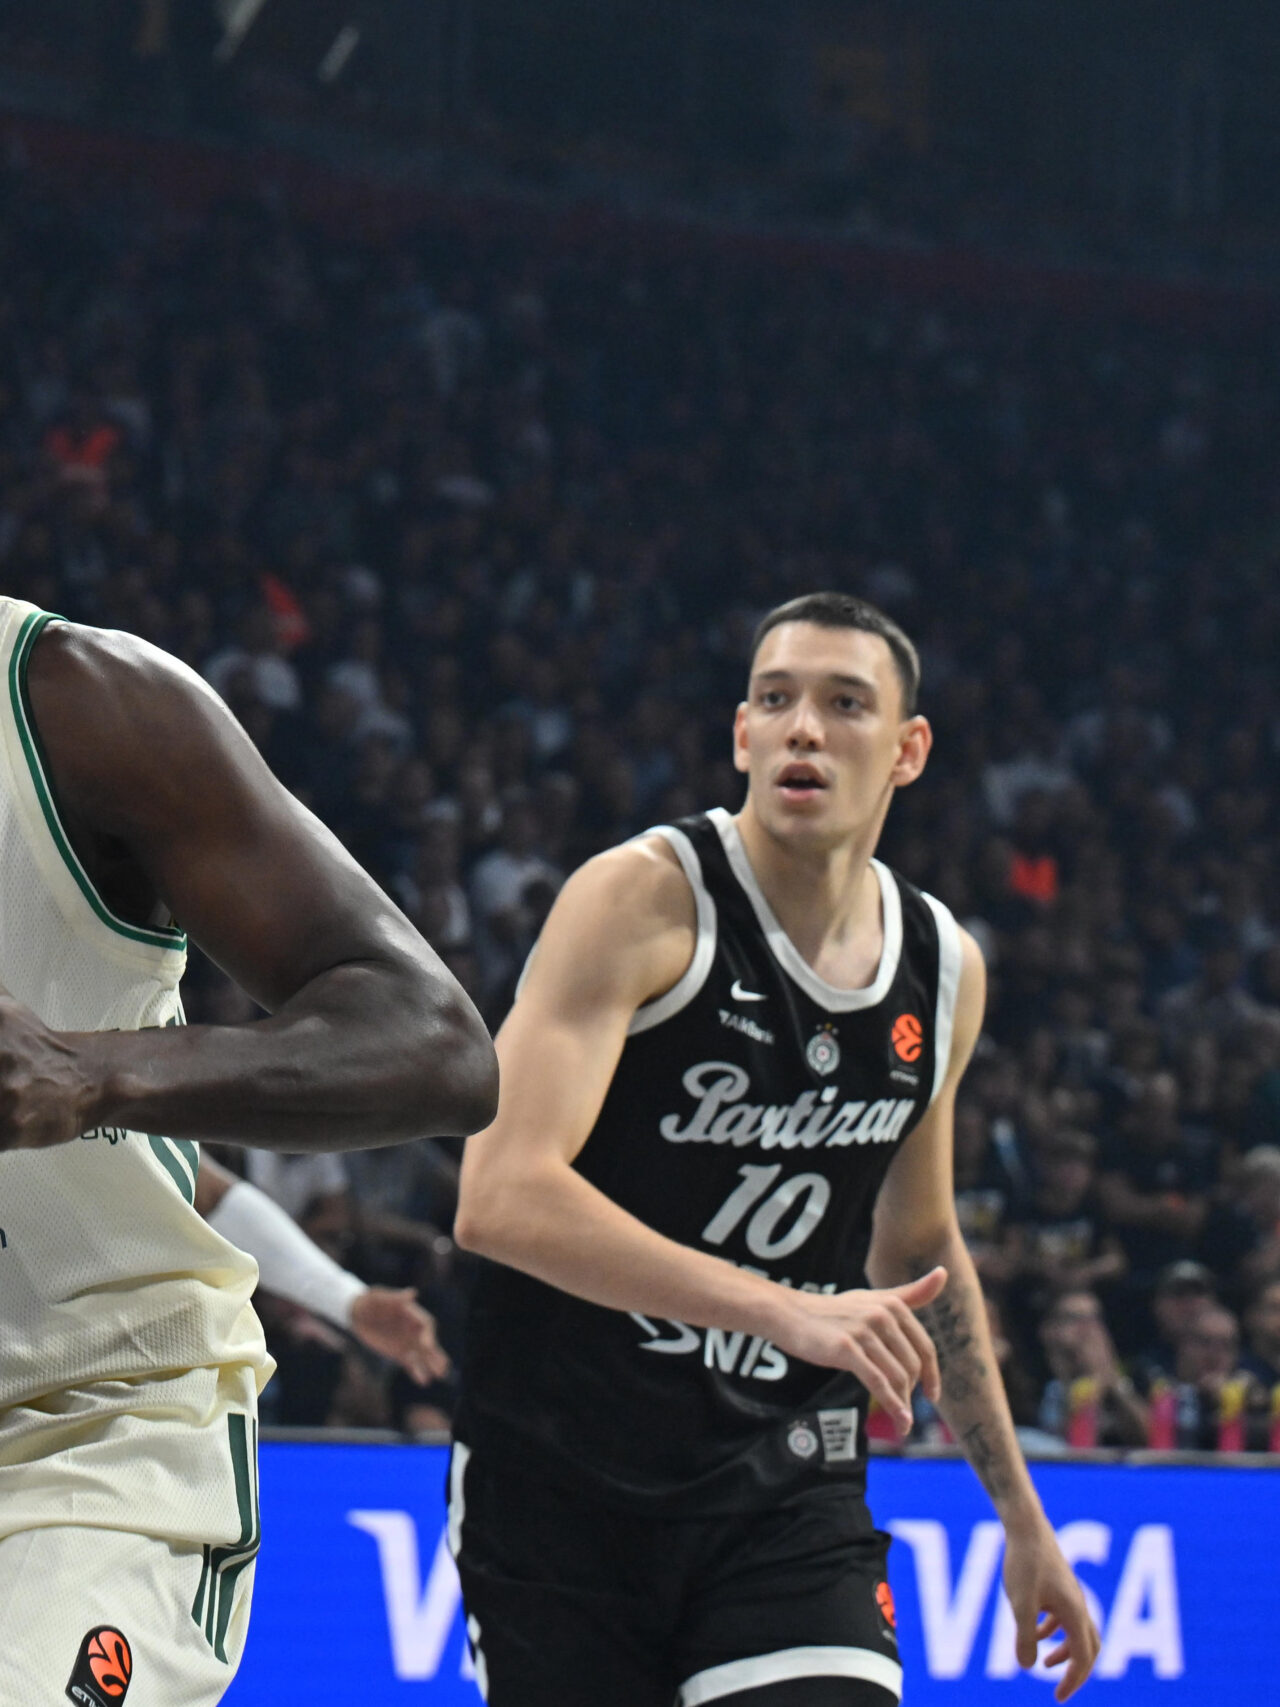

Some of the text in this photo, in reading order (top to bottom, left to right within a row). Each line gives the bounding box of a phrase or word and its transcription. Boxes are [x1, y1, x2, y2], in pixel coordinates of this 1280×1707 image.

[659, 1060, 916, 1150] Partizan
[701, 1162, 832, 1261] 10
[703, 1327, 789, 1382] NIS
